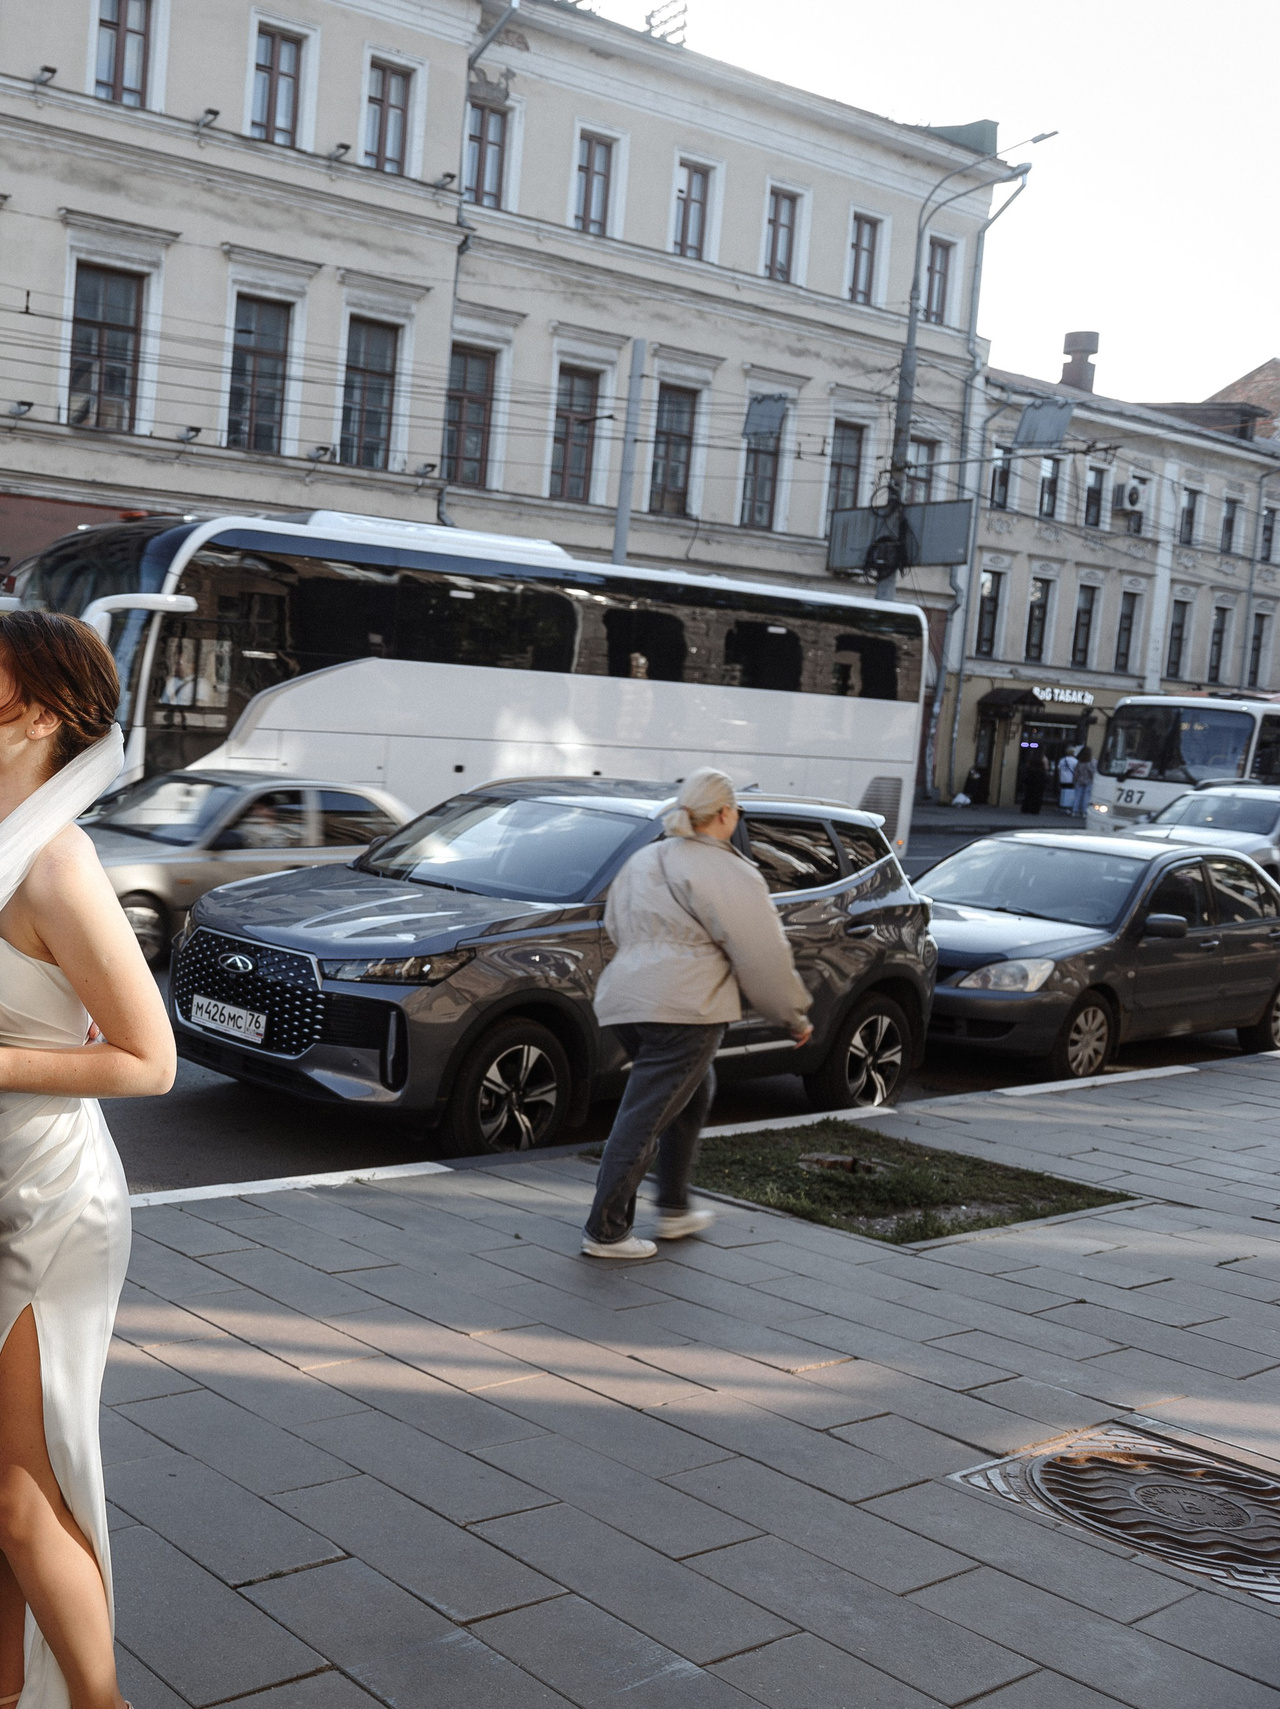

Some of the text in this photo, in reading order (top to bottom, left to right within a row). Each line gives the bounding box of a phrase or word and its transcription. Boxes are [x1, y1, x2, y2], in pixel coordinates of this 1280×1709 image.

[1053, 688, 1083, 704] ТАБАК
[1116, 788, 1146, 805] 787
[195, 1001, 262, 1030] М426МС 76
